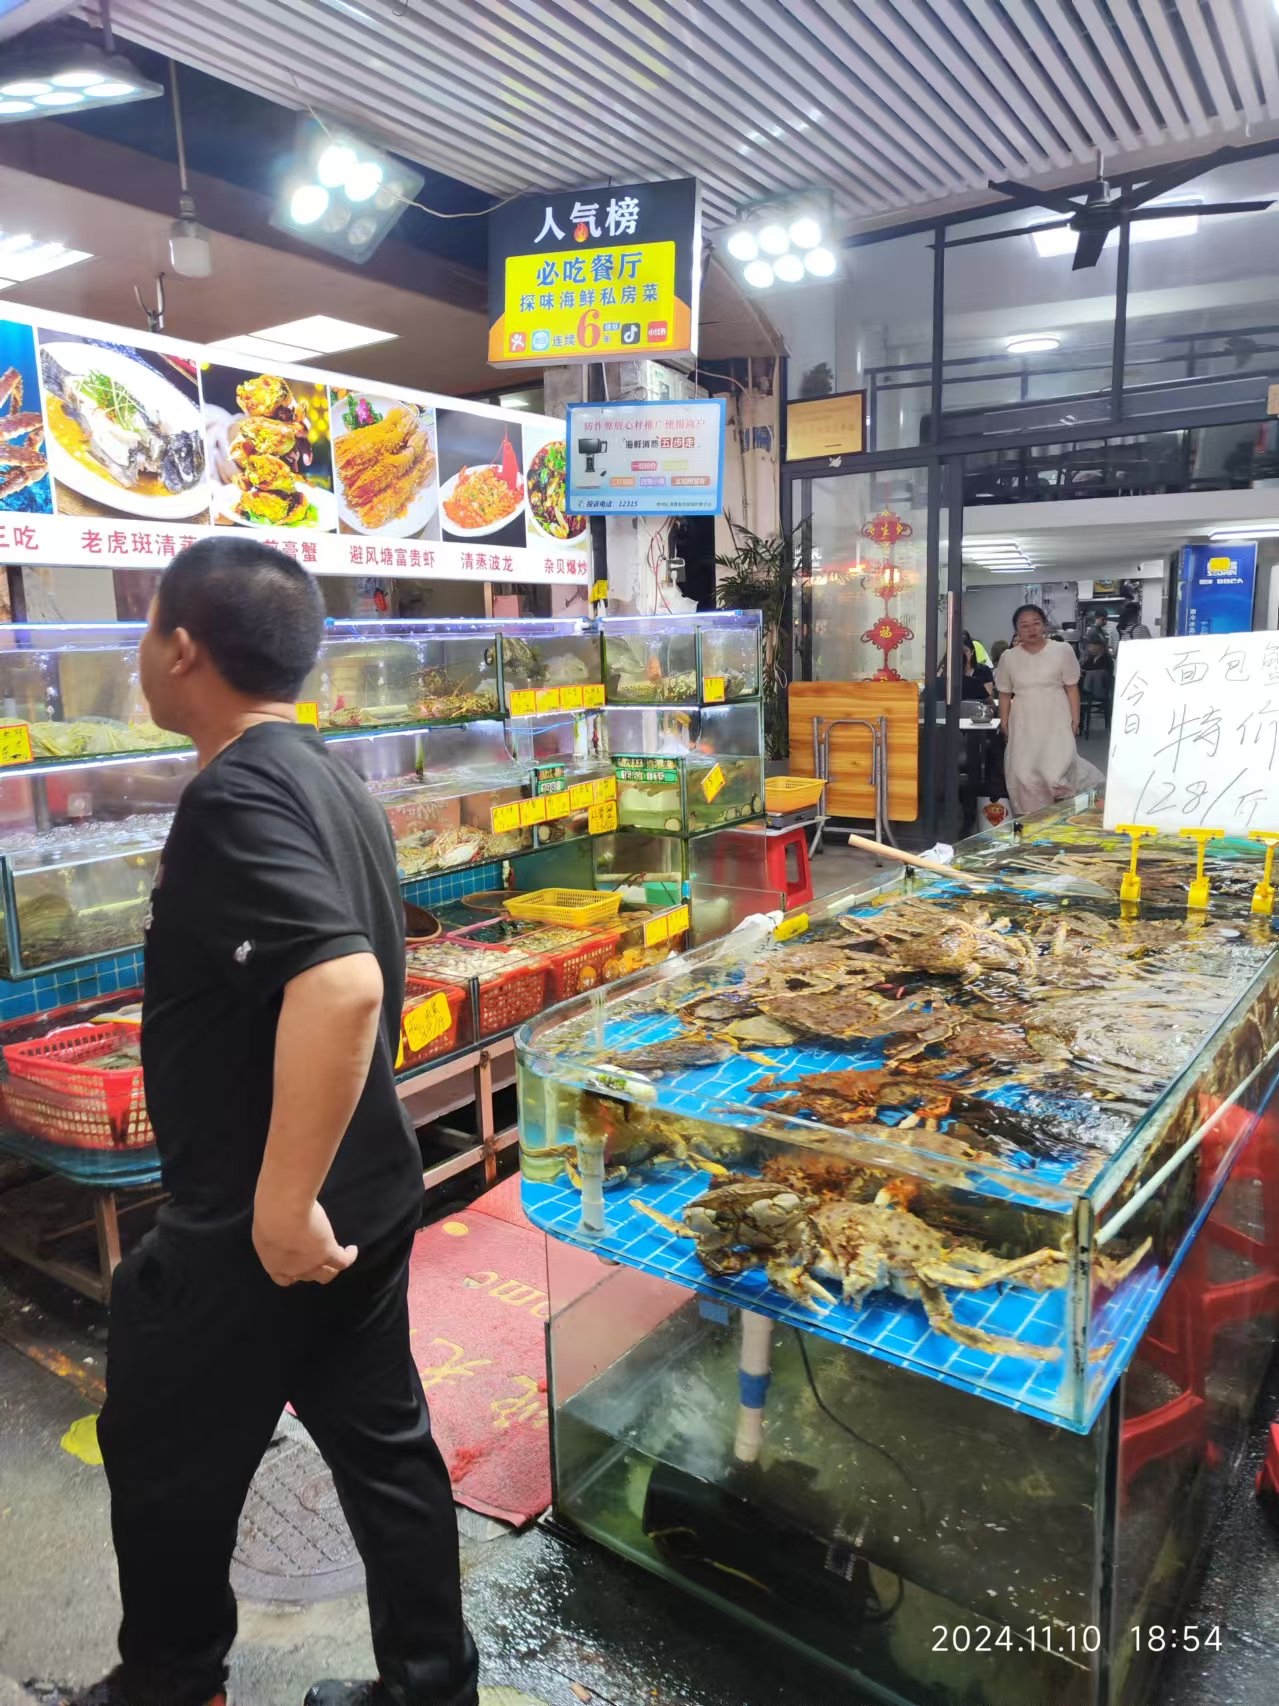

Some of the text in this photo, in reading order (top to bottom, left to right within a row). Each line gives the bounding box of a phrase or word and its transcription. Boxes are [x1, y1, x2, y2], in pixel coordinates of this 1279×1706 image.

[533, 196, 640, 244] 人气榜
[536, 252, 643, 287] 必吃餐厅
[519, 283, 660, 312] 探味海鲜私房菜
[576, 308, 601, 348] 6
[349, 544, 435, 569] 避风塘富贵虾
[460, 551, 515, 573] 清蒸波龙
[544, 558, 588, 575] 杂贝爆炒
[879, 626, 892, 638] 福
[1119, 670, 1149, 735] 今日
[1153, 700, 1279, 774] 特价
[1131, 767, 1268, 828] 128/斤
